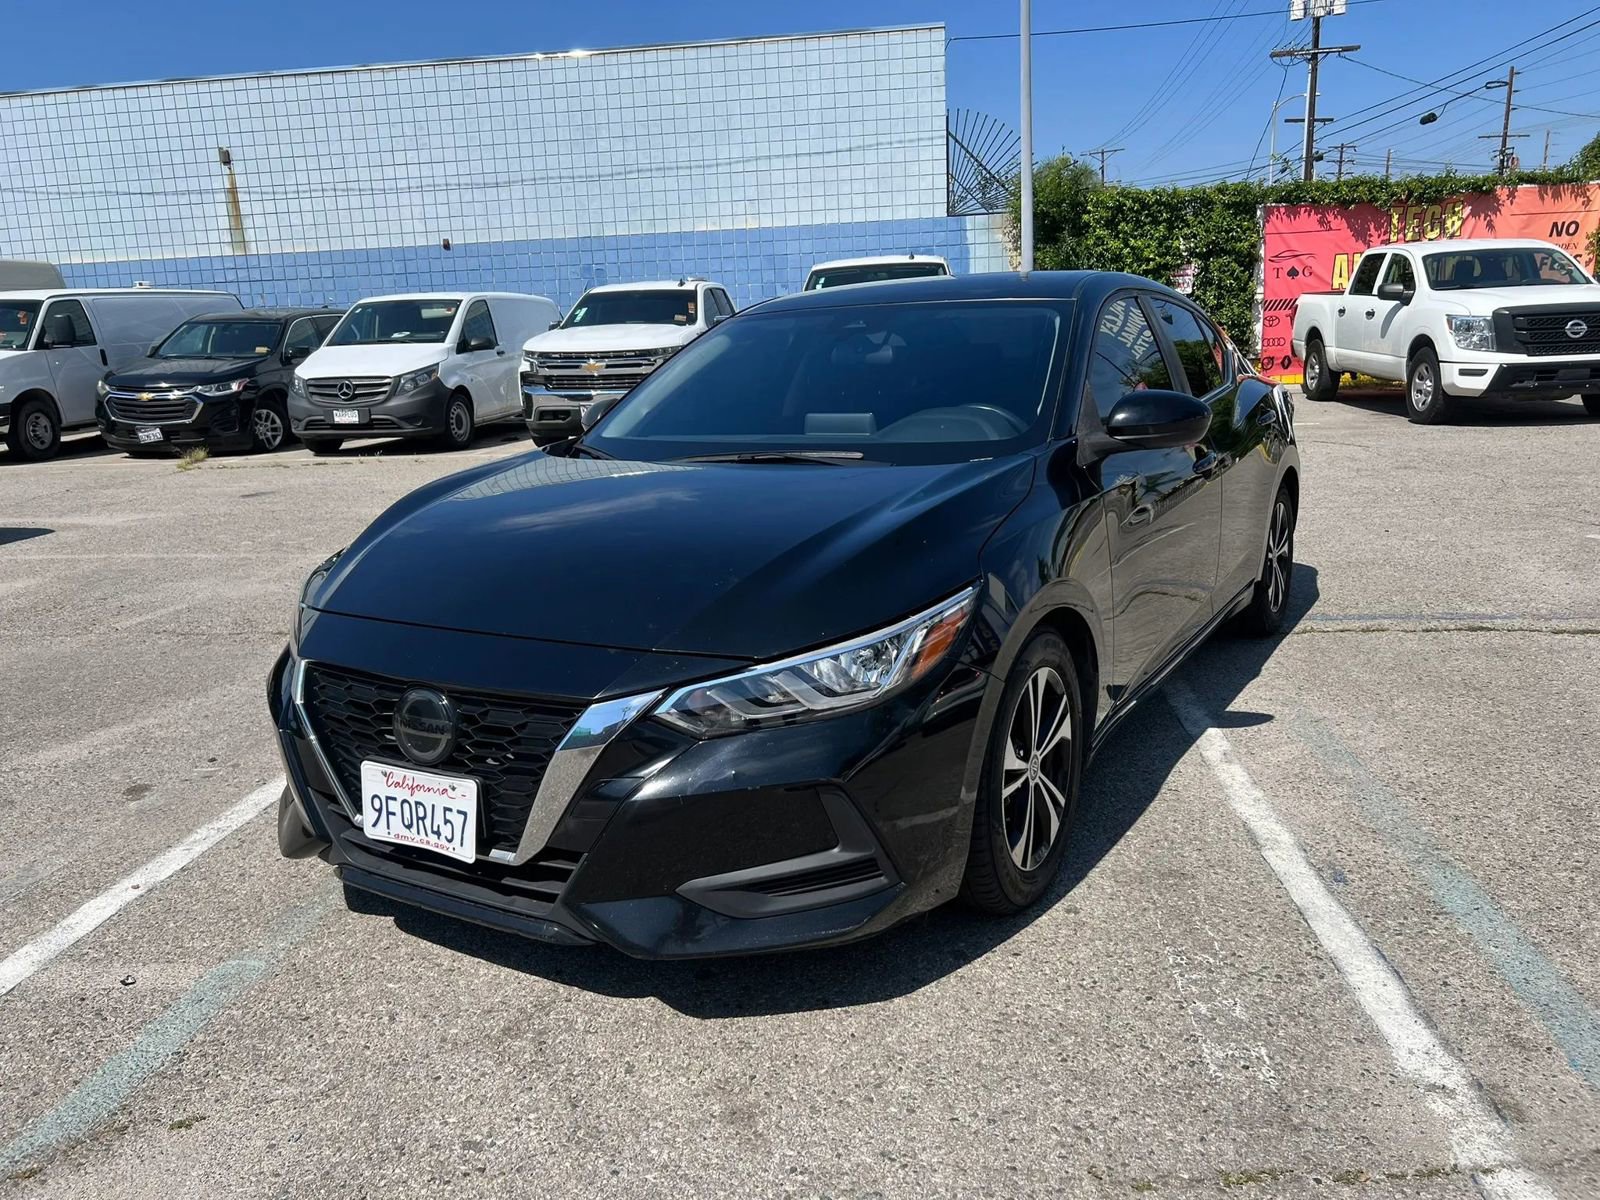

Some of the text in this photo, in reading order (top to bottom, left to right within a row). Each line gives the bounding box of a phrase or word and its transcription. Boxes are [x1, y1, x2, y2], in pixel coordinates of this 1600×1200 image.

[1387, 200, 1464, 243] TECH
[1548, 220, 1580, 238] NO
[385, 770, 457, 800] California
[370, 793, 469, 848] 9FQR457
[393, 832, 451, 852] dmv.ca.gov
